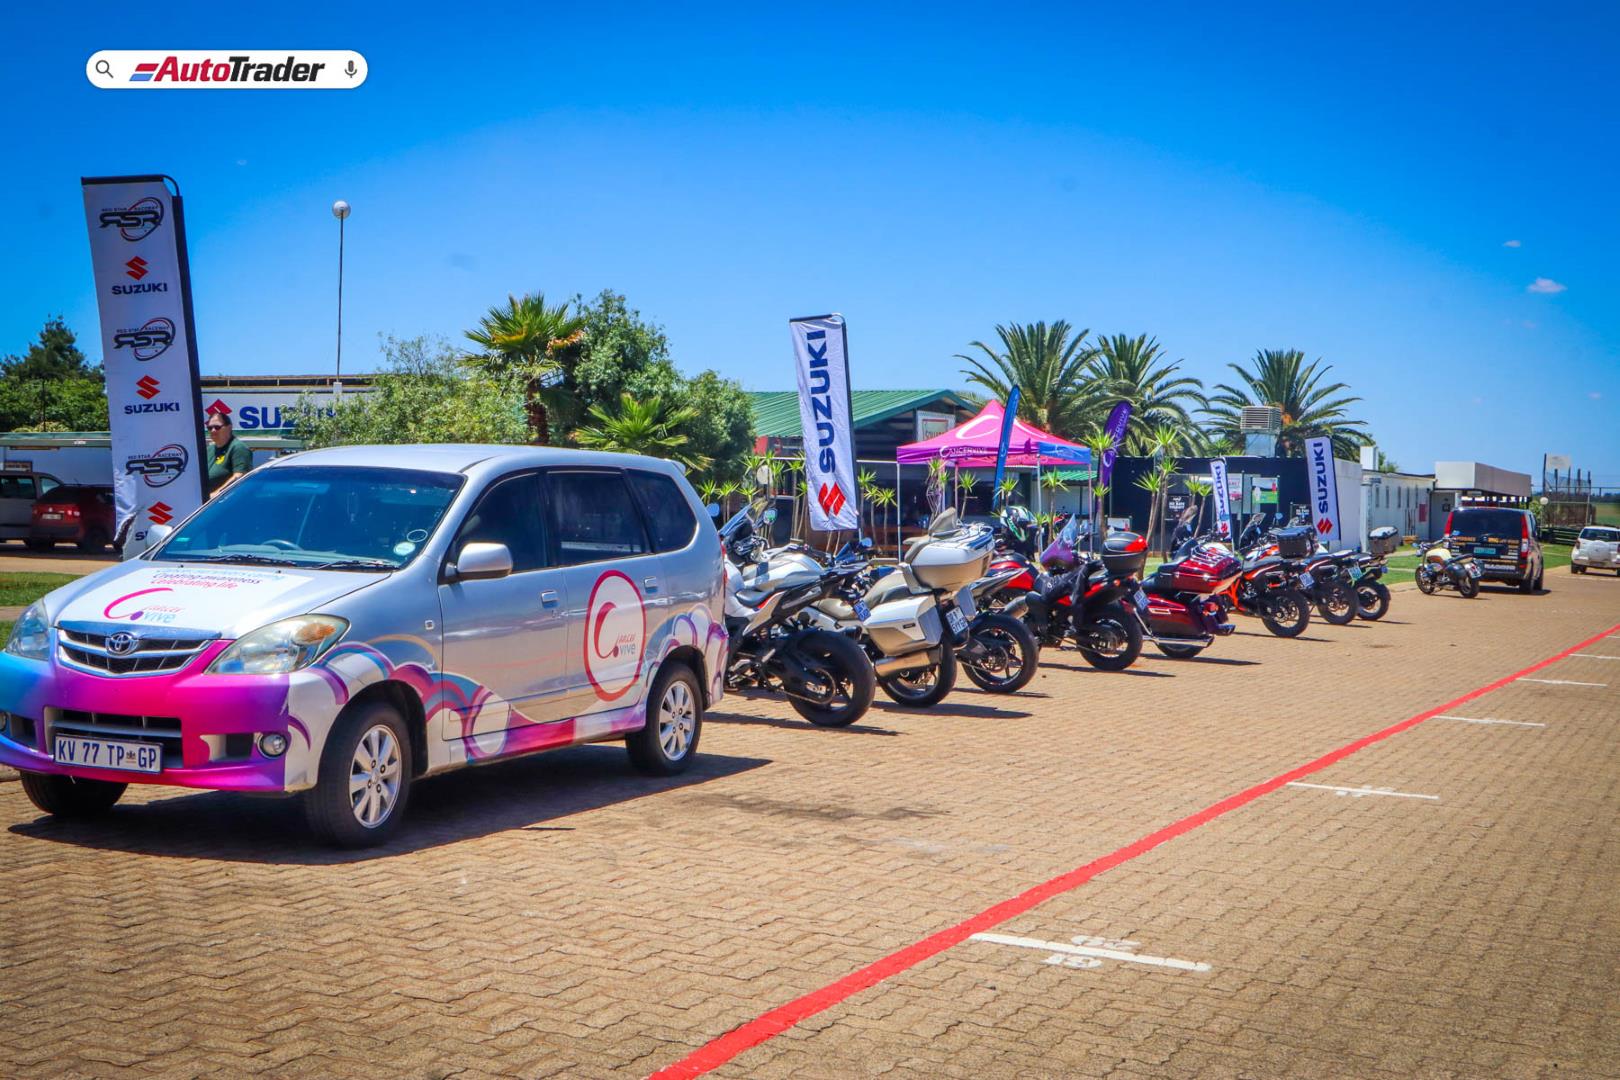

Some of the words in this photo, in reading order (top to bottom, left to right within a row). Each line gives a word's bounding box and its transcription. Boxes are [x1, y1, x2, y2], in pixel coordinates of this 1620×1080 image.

[112, 282, 168, 295] SUZUKI
[124, 402, 180, 414] SUZUKI
[807, 330, 836, 473] SUZUKI
[1313, 442, 1329, 514] SUZUKI
[59, 740, 76, 761] KV
[82, 742, 100, 764] 77
[107, 744, 125, 766] TP
[138, 747, 157, 769] GP
